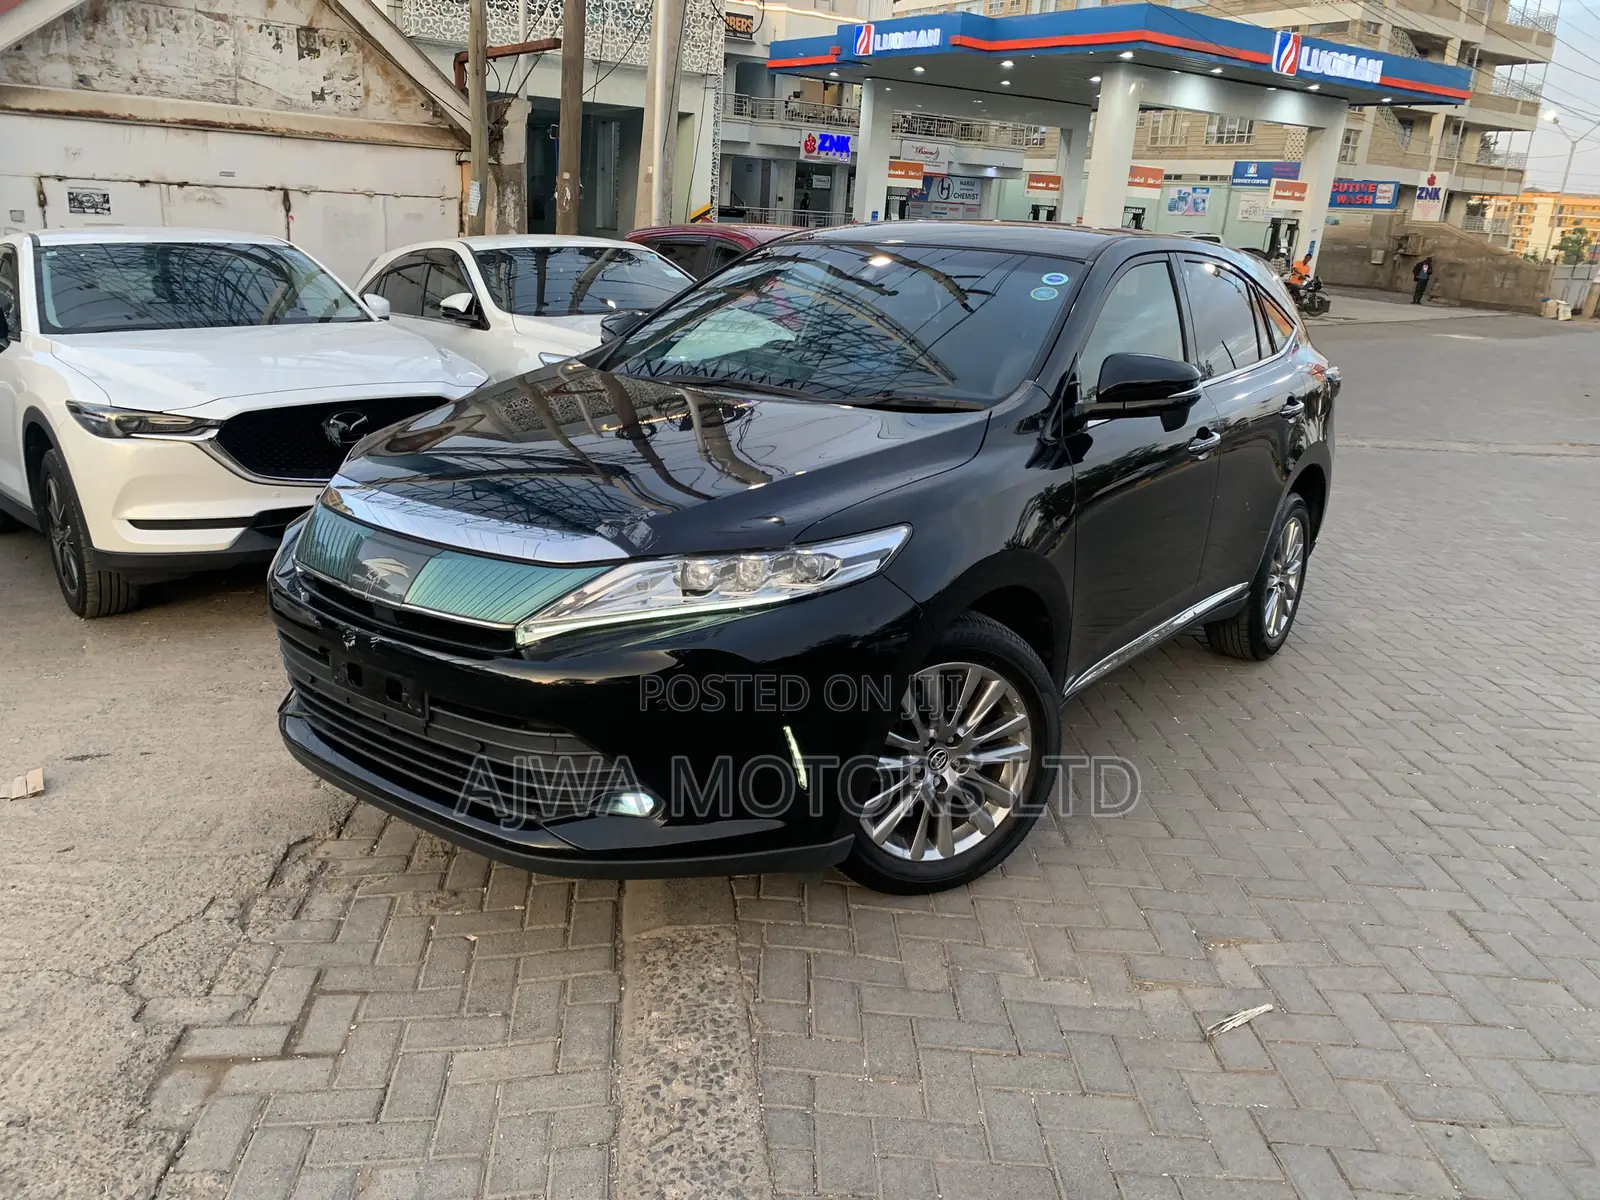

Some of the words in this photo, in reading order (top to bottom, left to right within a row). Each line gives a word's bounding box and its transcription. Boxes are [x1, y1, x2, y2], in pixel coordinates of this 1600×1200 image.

[874, 28, 941, 51] LUQMAN
[1300, 45, 1384, 84] LUQMAN
[817, 133, 851, 153] ZNK
[953, 192, 979, 200] CHEMIST
[1337, 195, 1373, 204] WASH
[1416, 186, 1441, 200] ZNK
